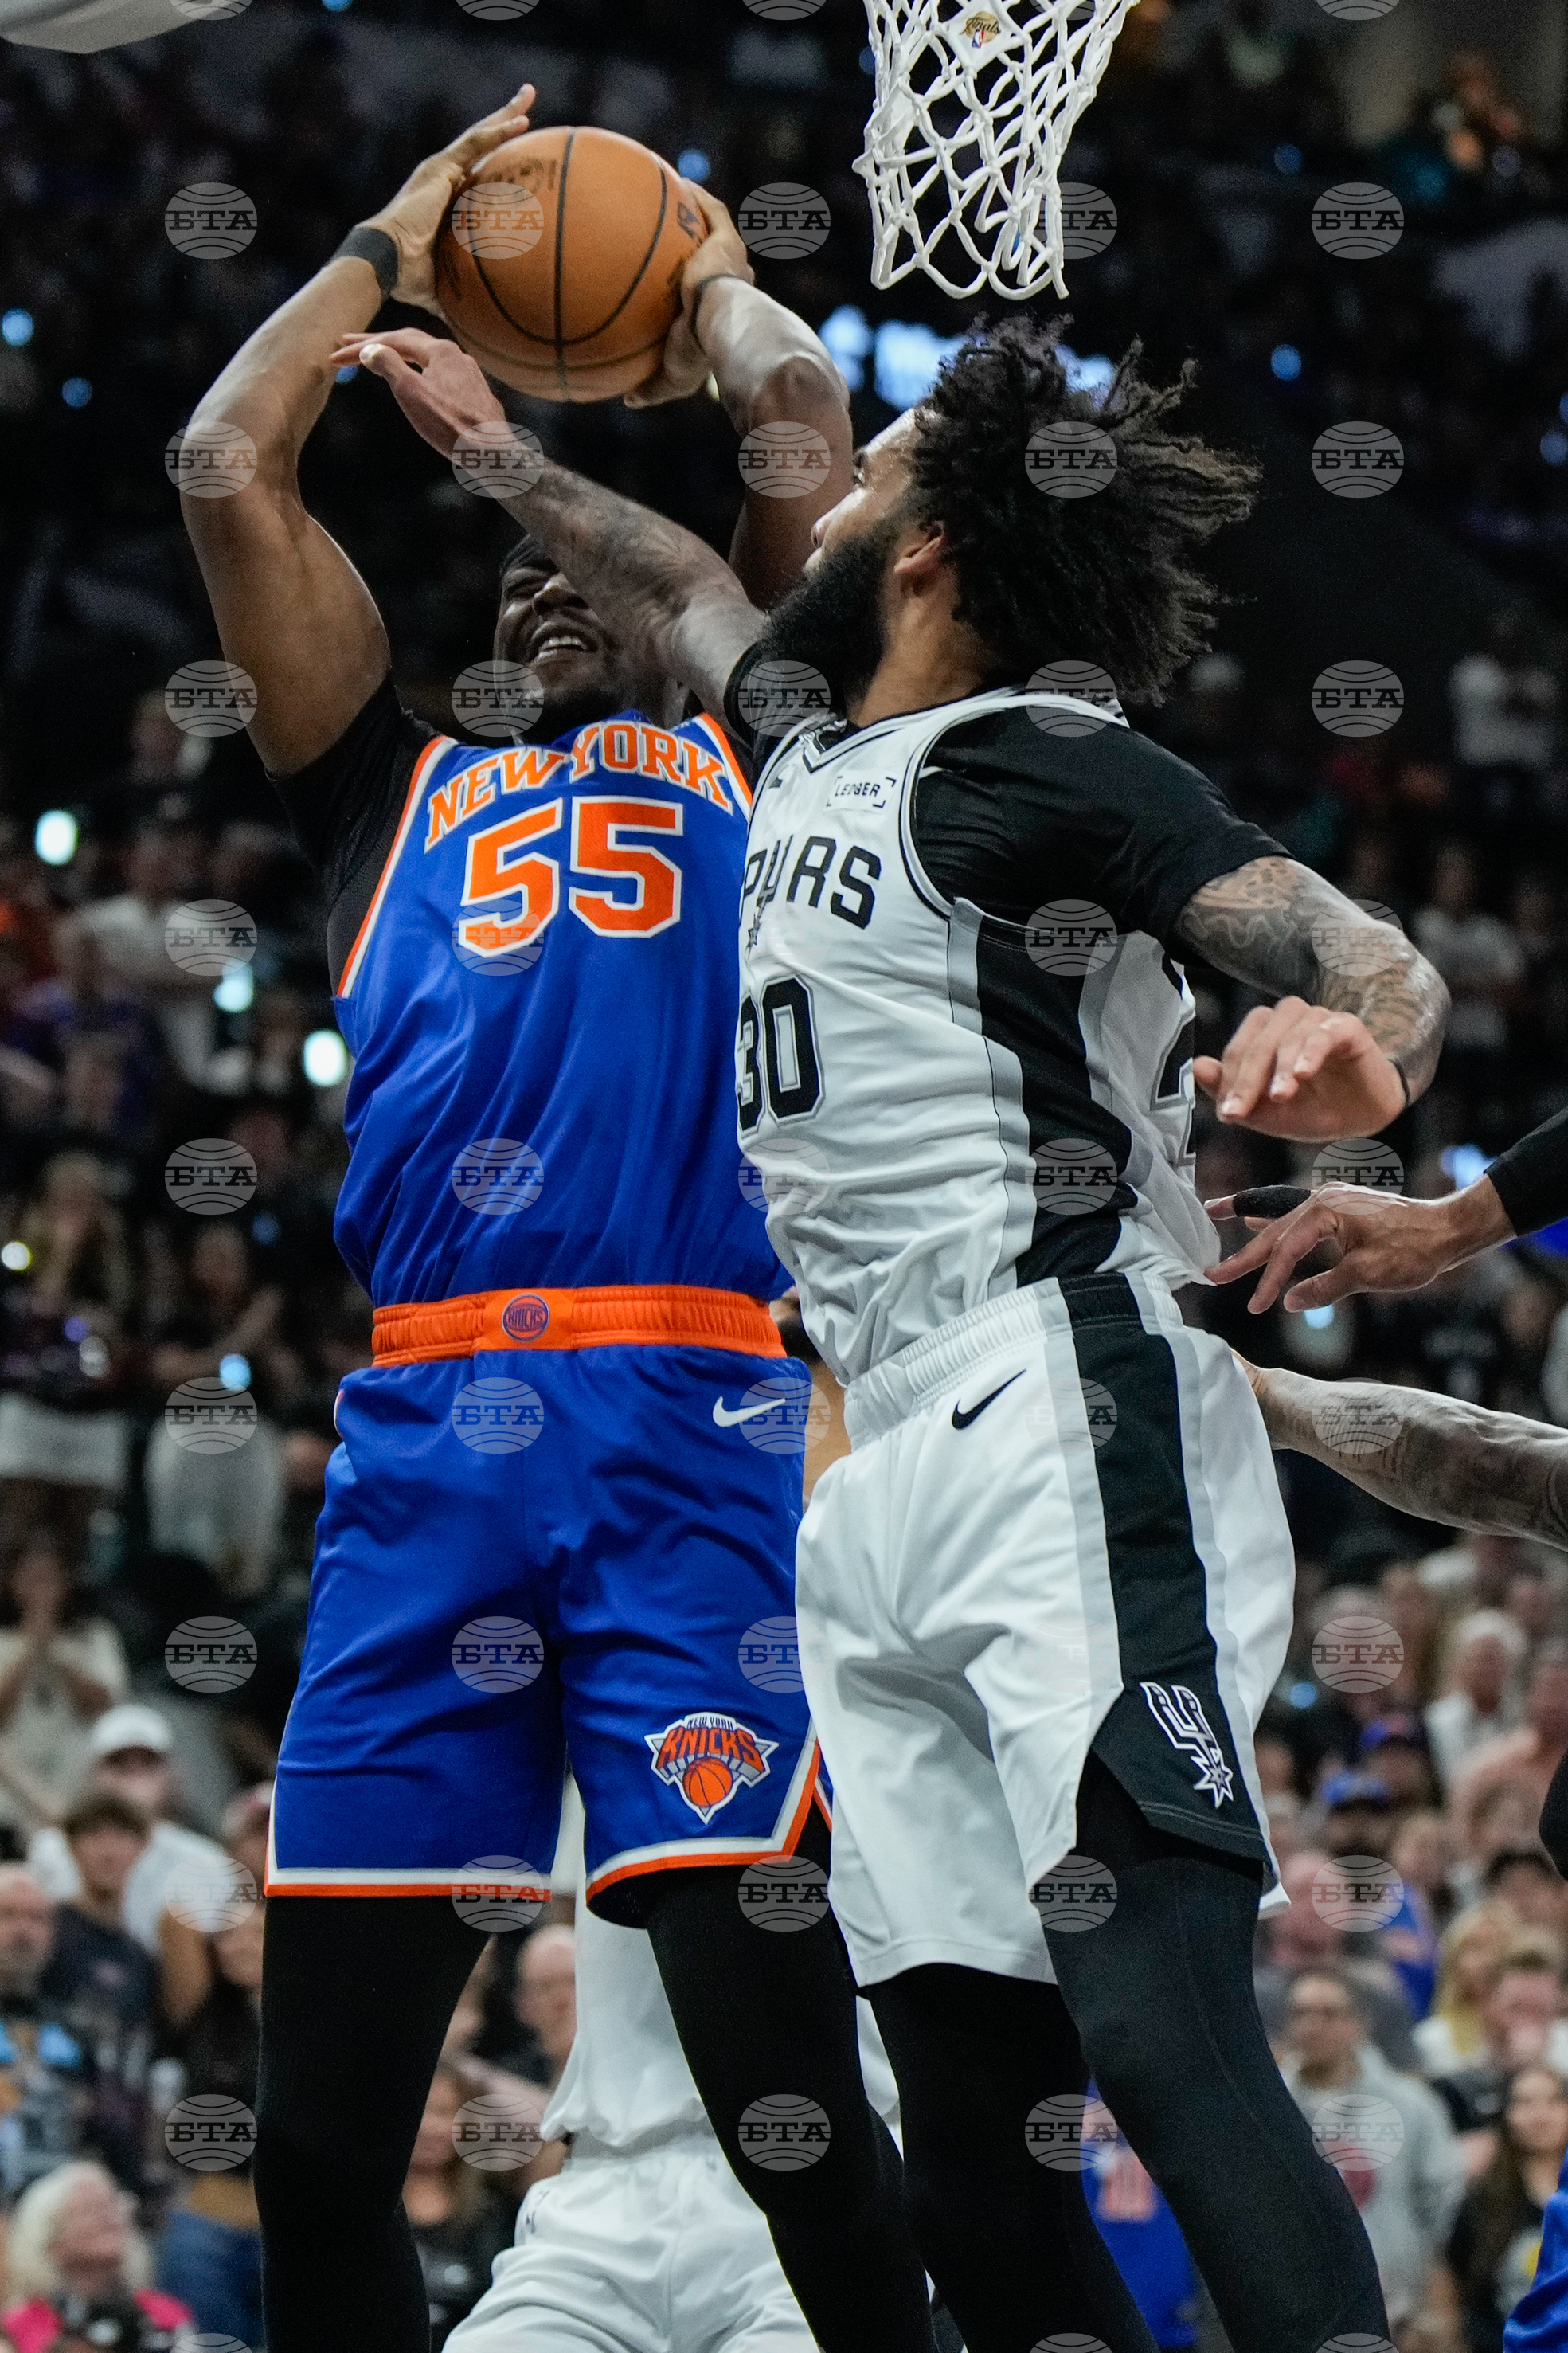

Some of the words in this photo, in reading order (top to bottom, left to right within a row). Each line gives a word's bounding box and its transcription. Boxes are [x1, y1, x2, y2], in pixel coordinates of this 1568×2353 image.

[424, 746, 568, 855] NEW
[569, 720, 733, 816] YORK
[458, 796, 684, 958] 55
[743, 834, 882, 931] PURS
[737, 973, 825, 1139] 30
[655, 1725, 766, 1773] KNICKS
[686, 1716, 708, 1730] NEW
[710, 1716, 734, 1731] YORK
